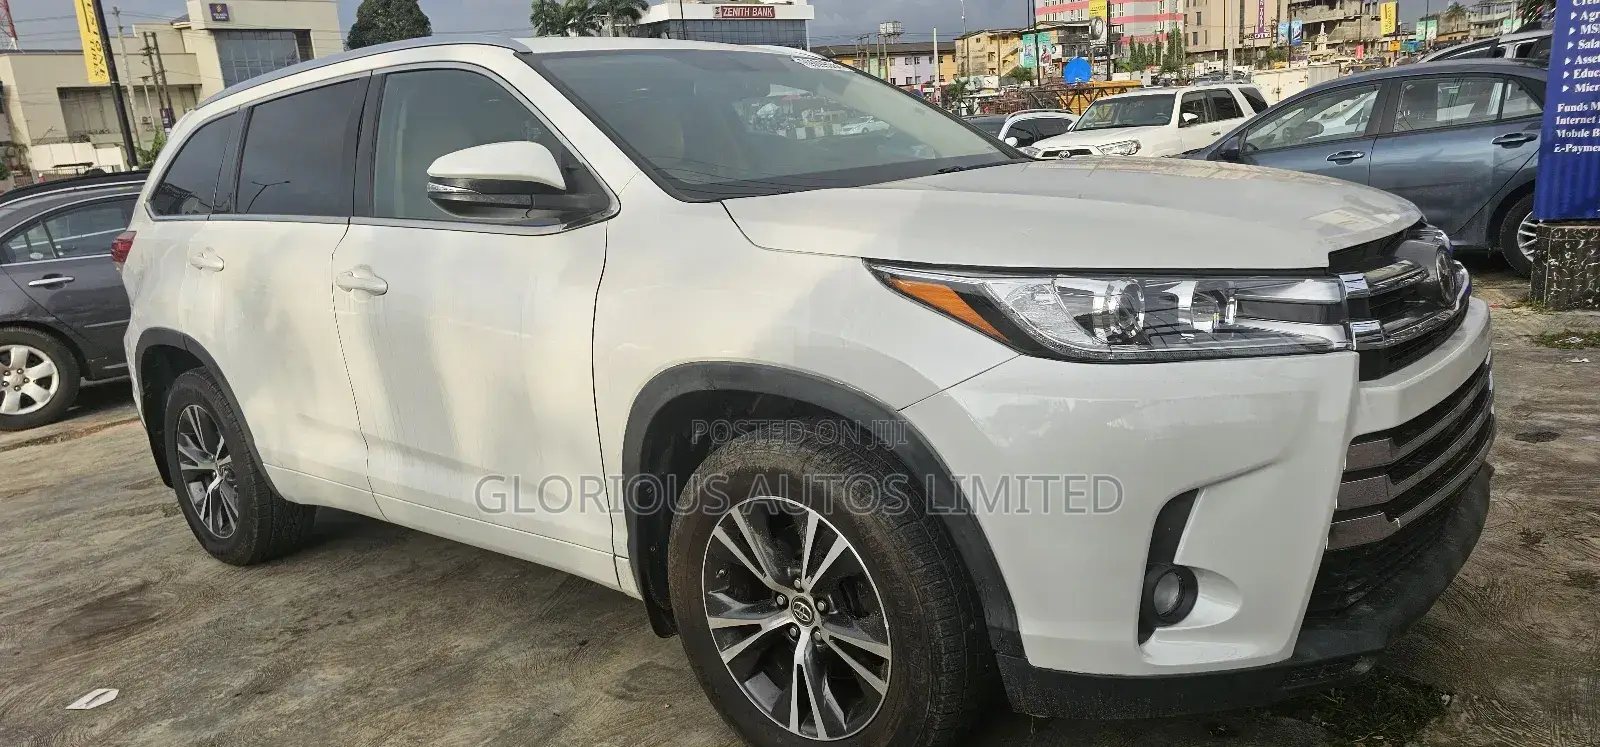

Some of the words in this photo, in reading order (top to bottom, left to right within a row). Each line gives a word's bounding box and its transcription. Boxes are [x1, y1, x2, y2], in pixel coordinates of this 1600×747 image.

[723, 7, 750, 17] ZENITH
[752, 7, 773, 17] BANK
[1573, 67, 1600, 80] Educ
[1557, 102, 1589, 113] Funds
[1555, 115, 1597, 125] Internet
[1556, 128, 1590, 138] Mobile
